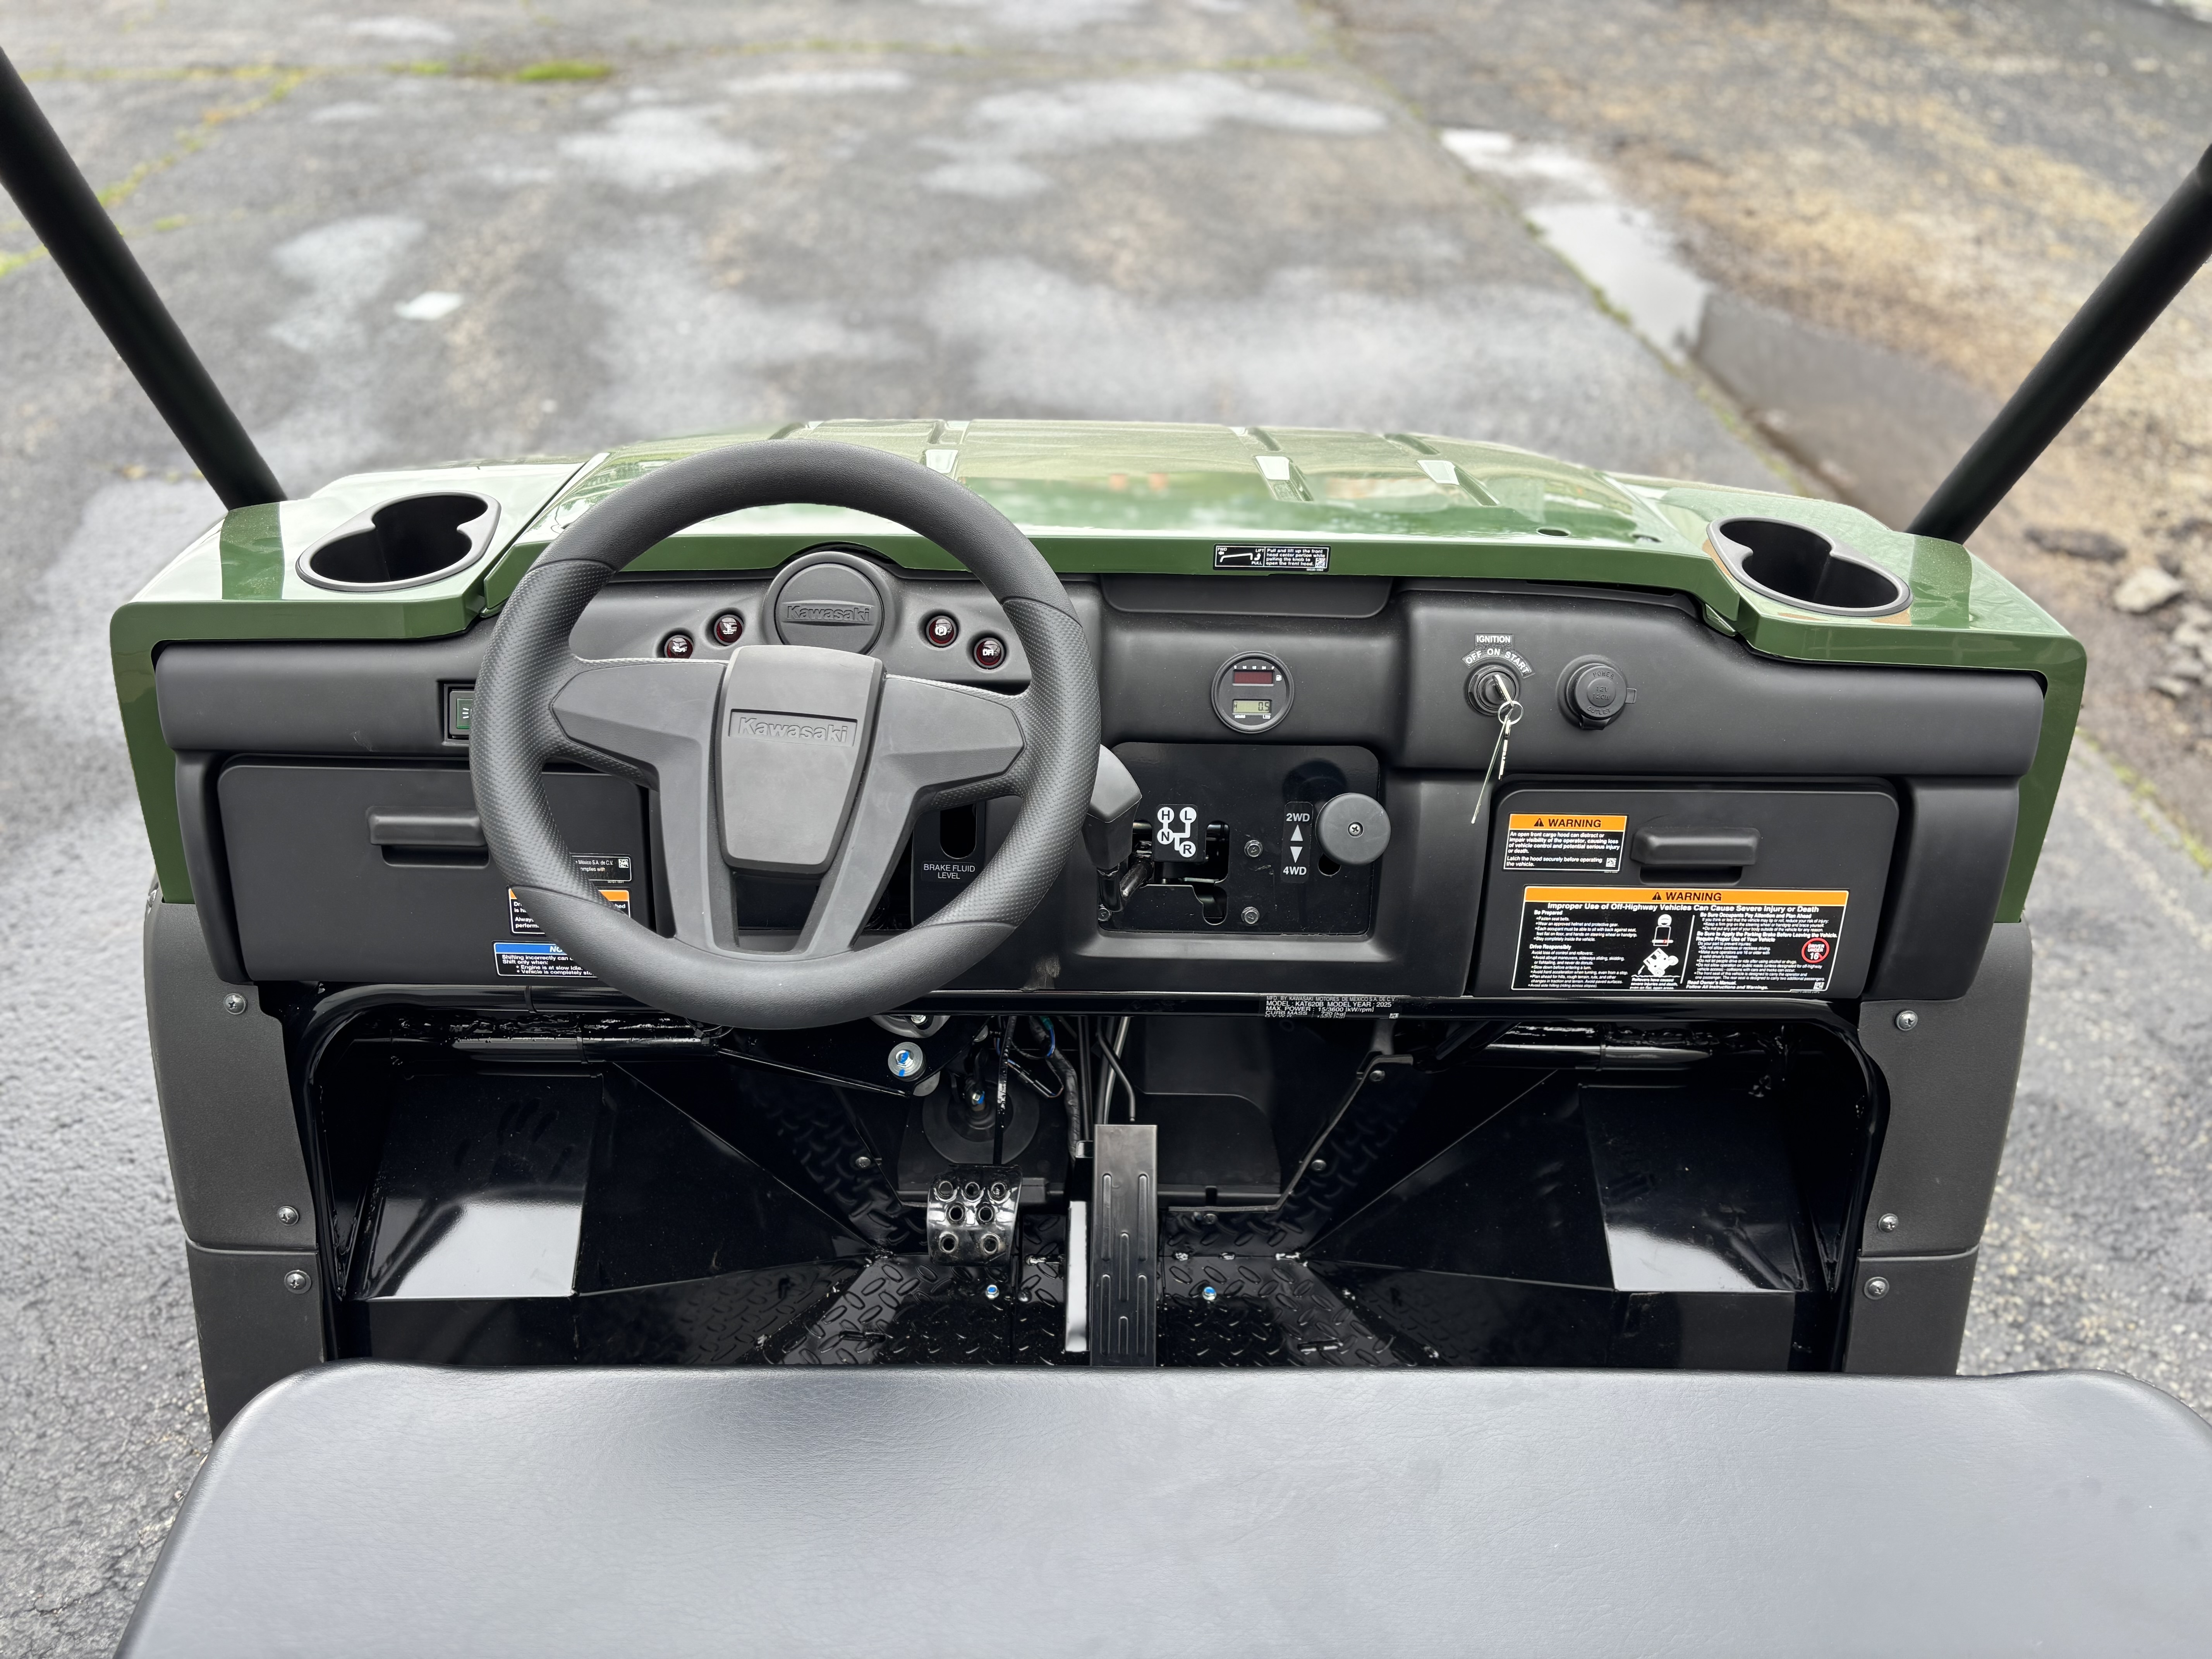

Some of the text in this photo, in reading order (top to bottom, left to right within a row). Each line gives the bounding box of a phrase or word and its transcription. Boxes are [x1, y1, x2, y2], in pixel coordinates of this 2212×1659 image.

[787, 606, 869, 621] Kawasaki
[1465, 651, 1482, 664] OFF
[1504, 651, 1530, 673] START
[1592, 671, 1614, 679] POWER
[1587, 706, 1610, 715] OUTLET
[739, 717, 848, 742] Kawasaki
[1162, 810, 1192, 820] H L
[1286, 813, 1310, 822] 2WD
[1549, 819, 1601, 828] WARNING
[1161, 831, 1170, 842] N
[1183, 844, 1192, 854] R
[1283, 866, 1307, 876] 4WD
[1666, 892, 1722, 901] WARNING
